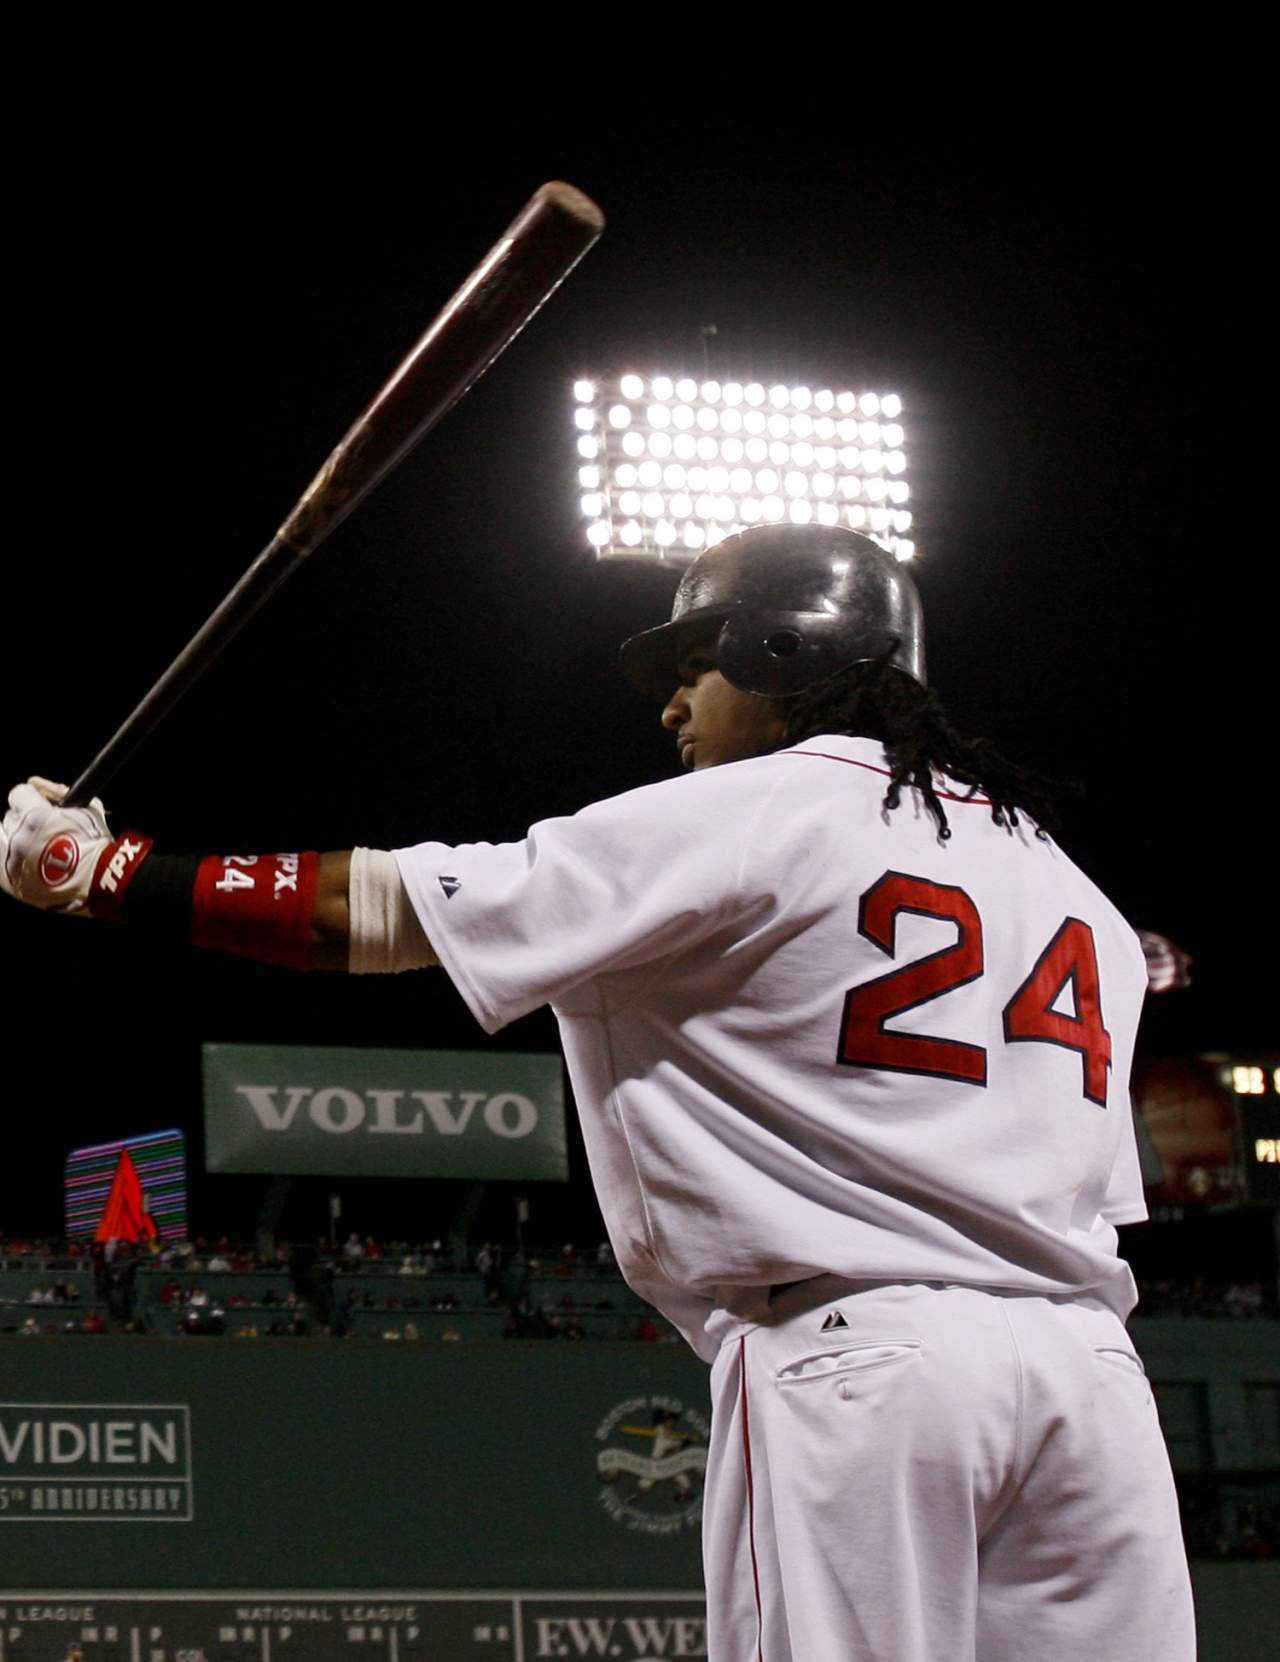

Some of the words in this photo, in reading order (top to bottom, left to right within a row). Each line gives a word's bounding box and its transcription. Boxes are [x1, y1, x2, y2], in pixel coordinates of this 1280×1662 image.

[99, 838, 144, 893] TPX
[215, 855, 259, 892] 24
[835, 869, 1112, 1109] 24
[235, 1085, 538, 1139] VOLVO
[31, 1487, 181, 1510] ANNIVERSARY
[16, 1607, 95, 1621] LEAGUE
[236, 1607, 332, 1621] NATIONAL
[341, 1607, 417, 1621] LEAGUE
[536, 1617, 621, 1656] F.W.
